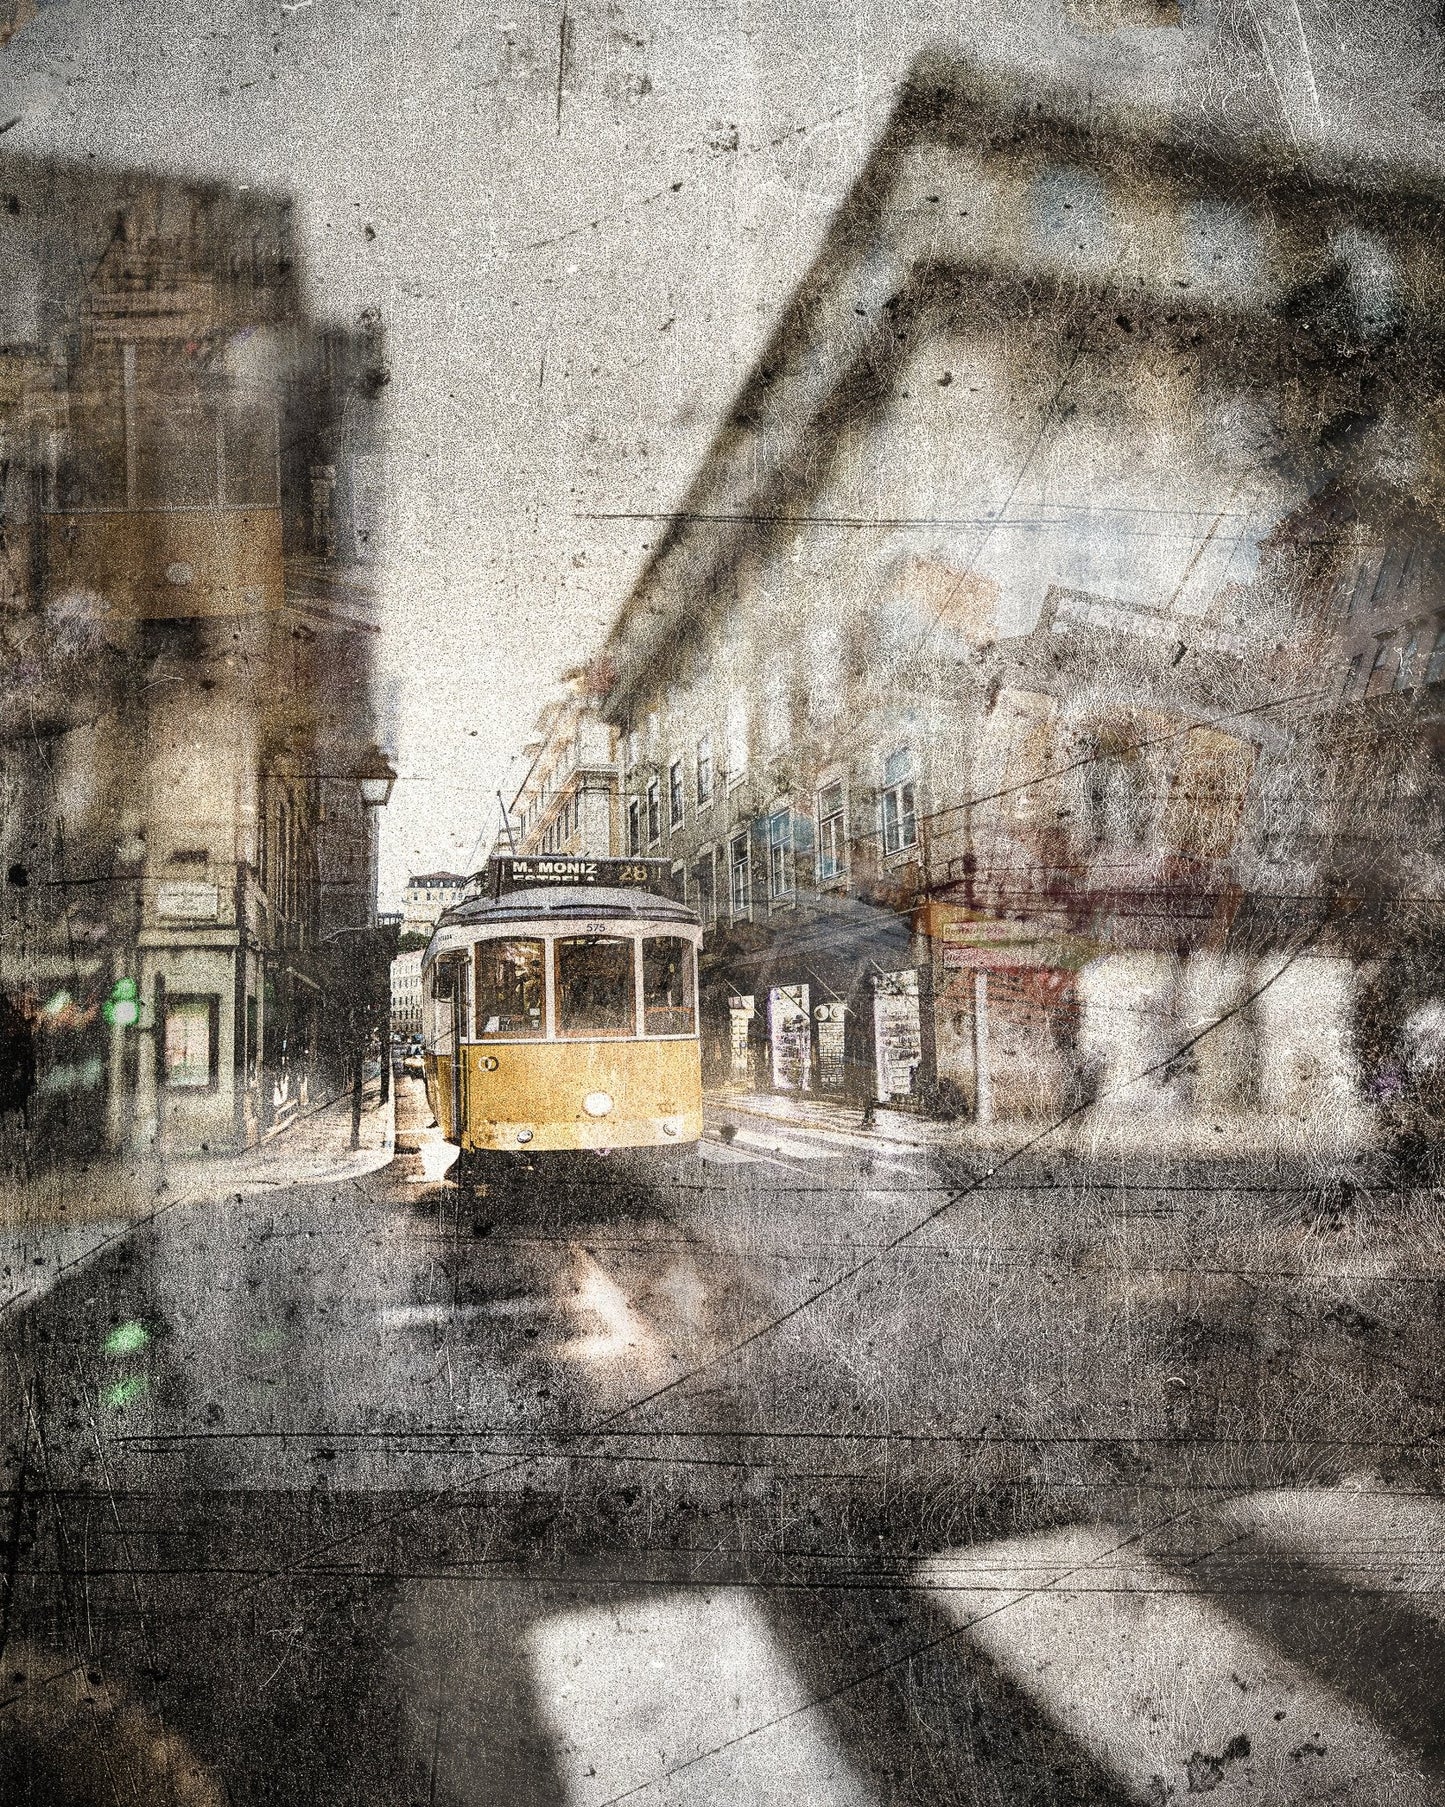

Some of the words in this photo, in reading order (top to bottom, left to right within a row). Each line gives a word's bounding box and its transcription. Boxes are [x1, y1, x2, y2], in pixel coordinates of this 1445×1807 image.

[512, 861, 532, 873] M.
[538, 862, 597, 873] MONIZ
[619, 865, 648, 881] 28
[586, 923, 605, 932] 575
